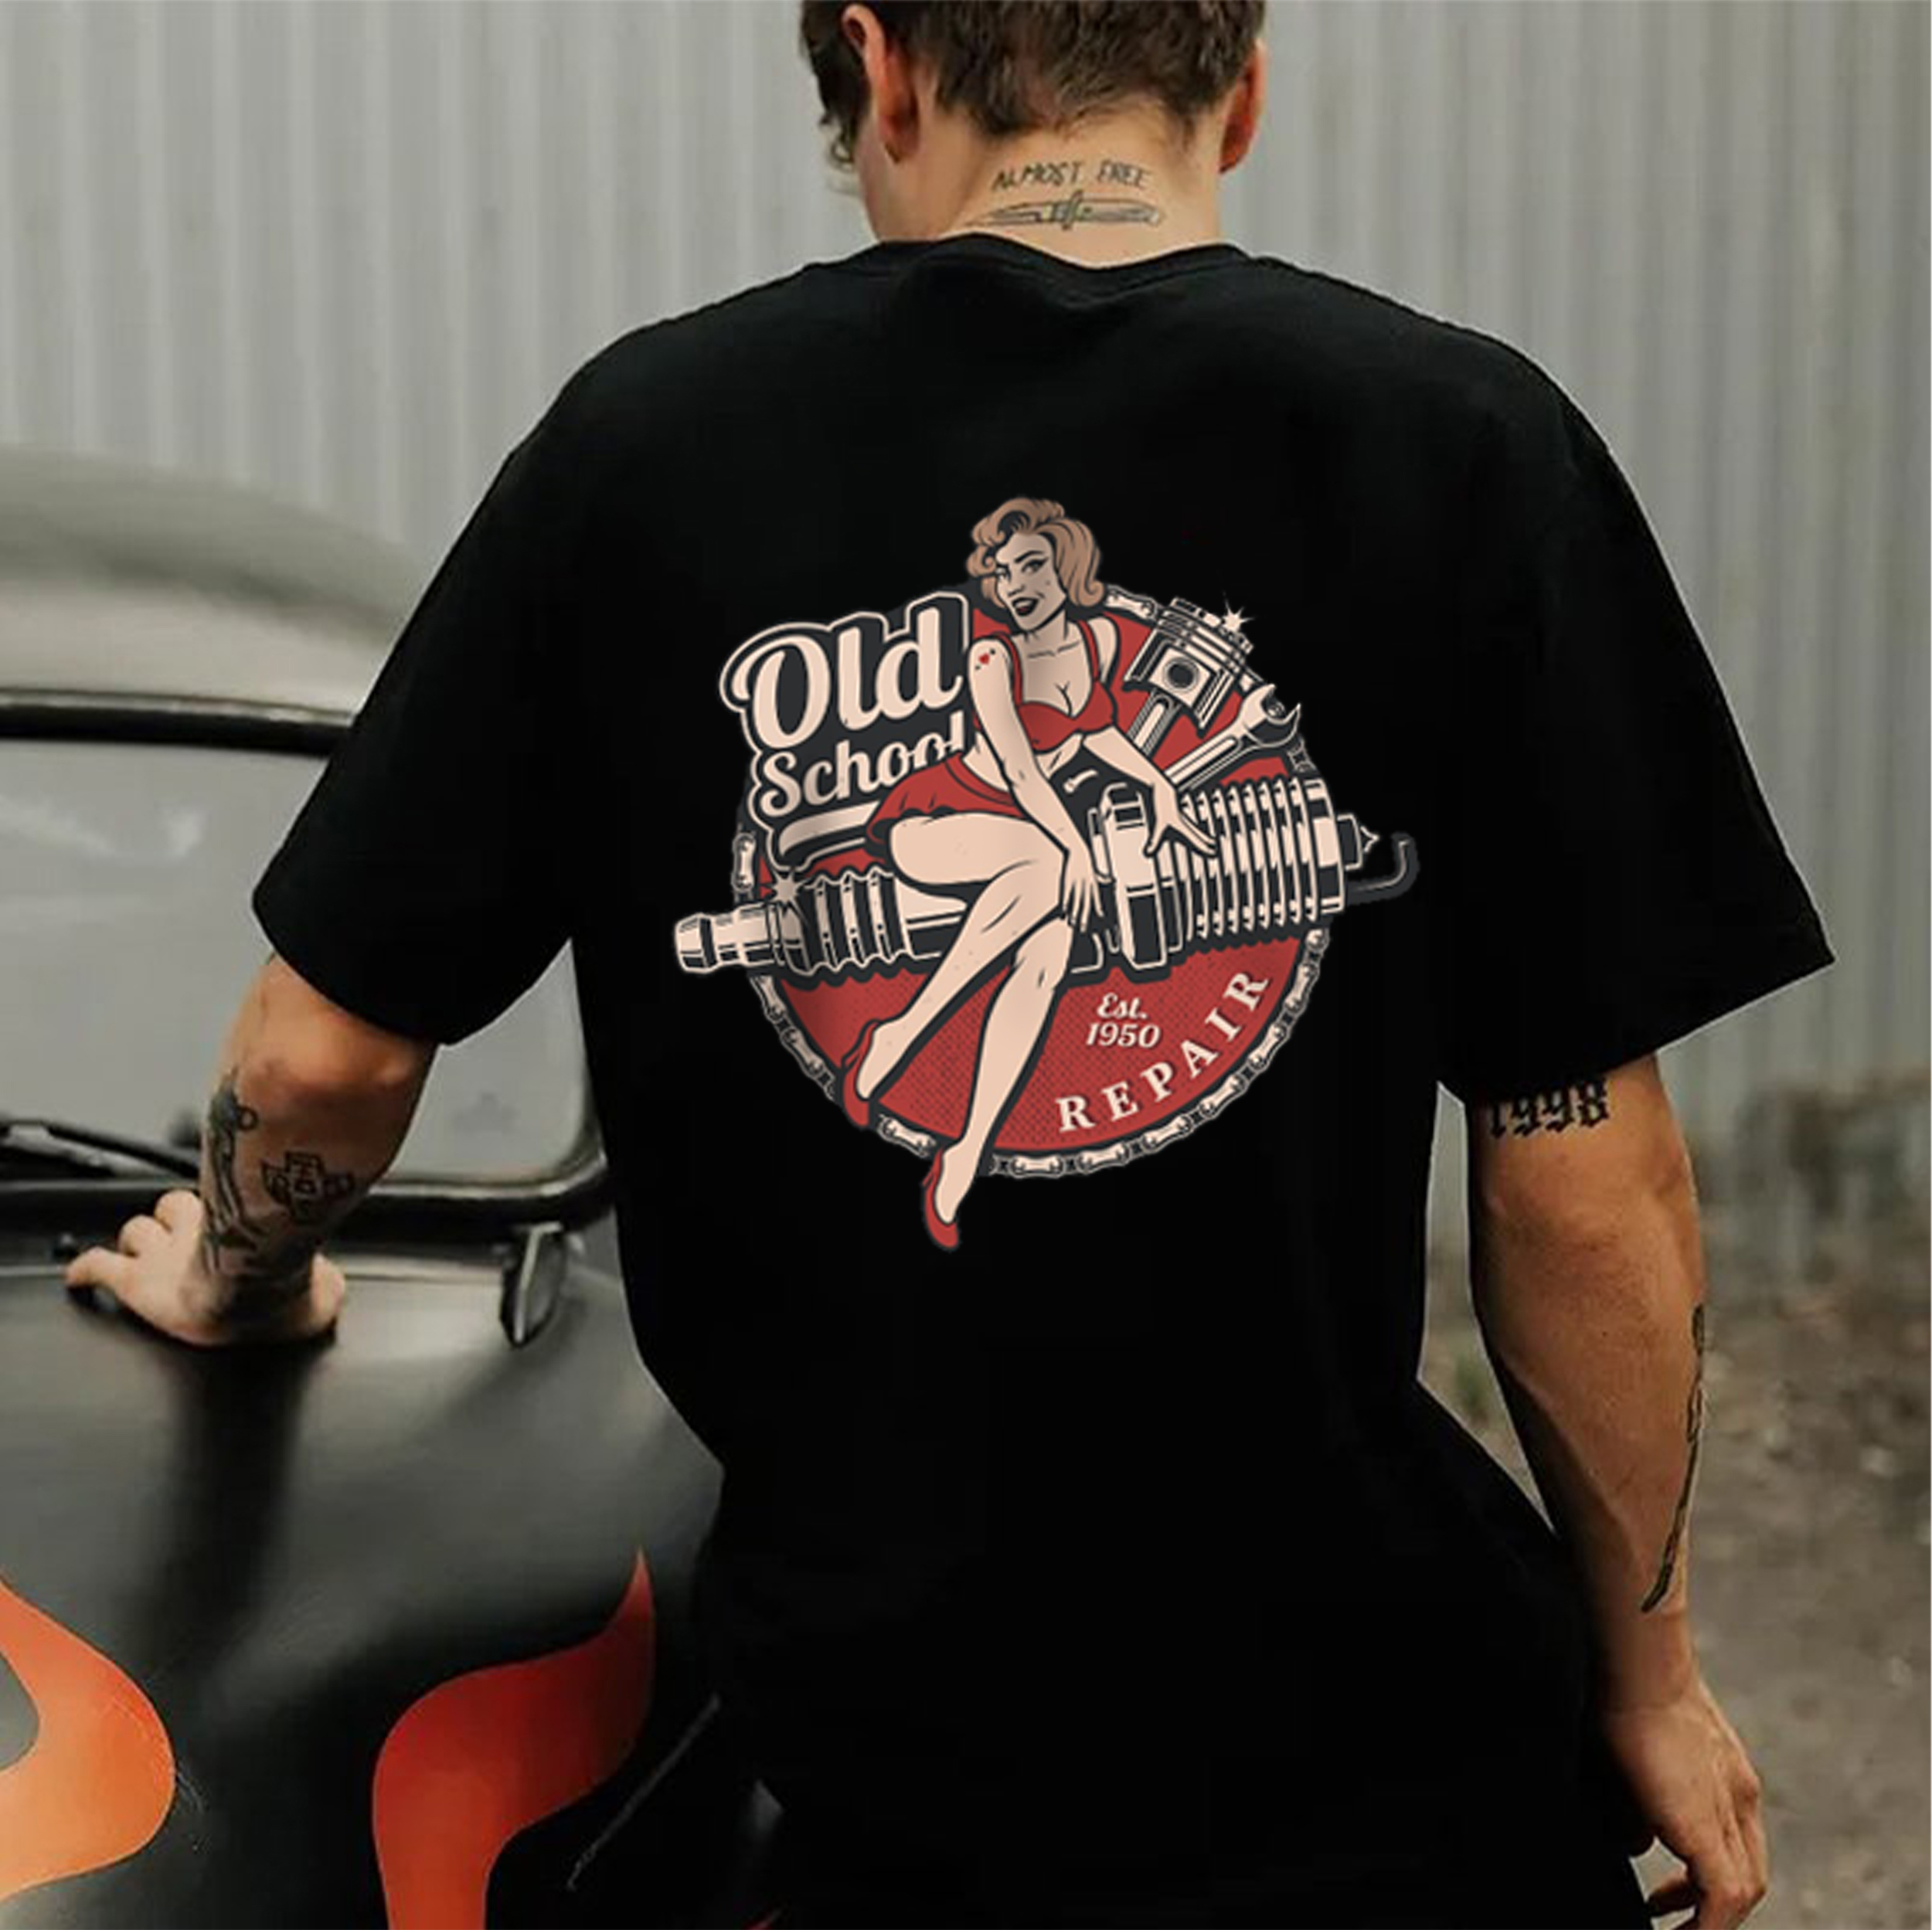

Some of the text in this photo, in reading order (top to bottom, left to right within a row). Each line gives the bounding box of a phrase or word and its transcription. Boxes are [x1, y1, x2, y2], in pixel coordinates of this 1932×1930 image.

[992, 159, 1151, 192] ALMOST FREE
[732, 607, 963, 748] Old
[760, 711, 963, 816] School
[1086, 1021, 1161, 1048] 1950
[1096, 992, 1148, 1019] Est.
[1055, 972, 1269, 1133] REPAIR
